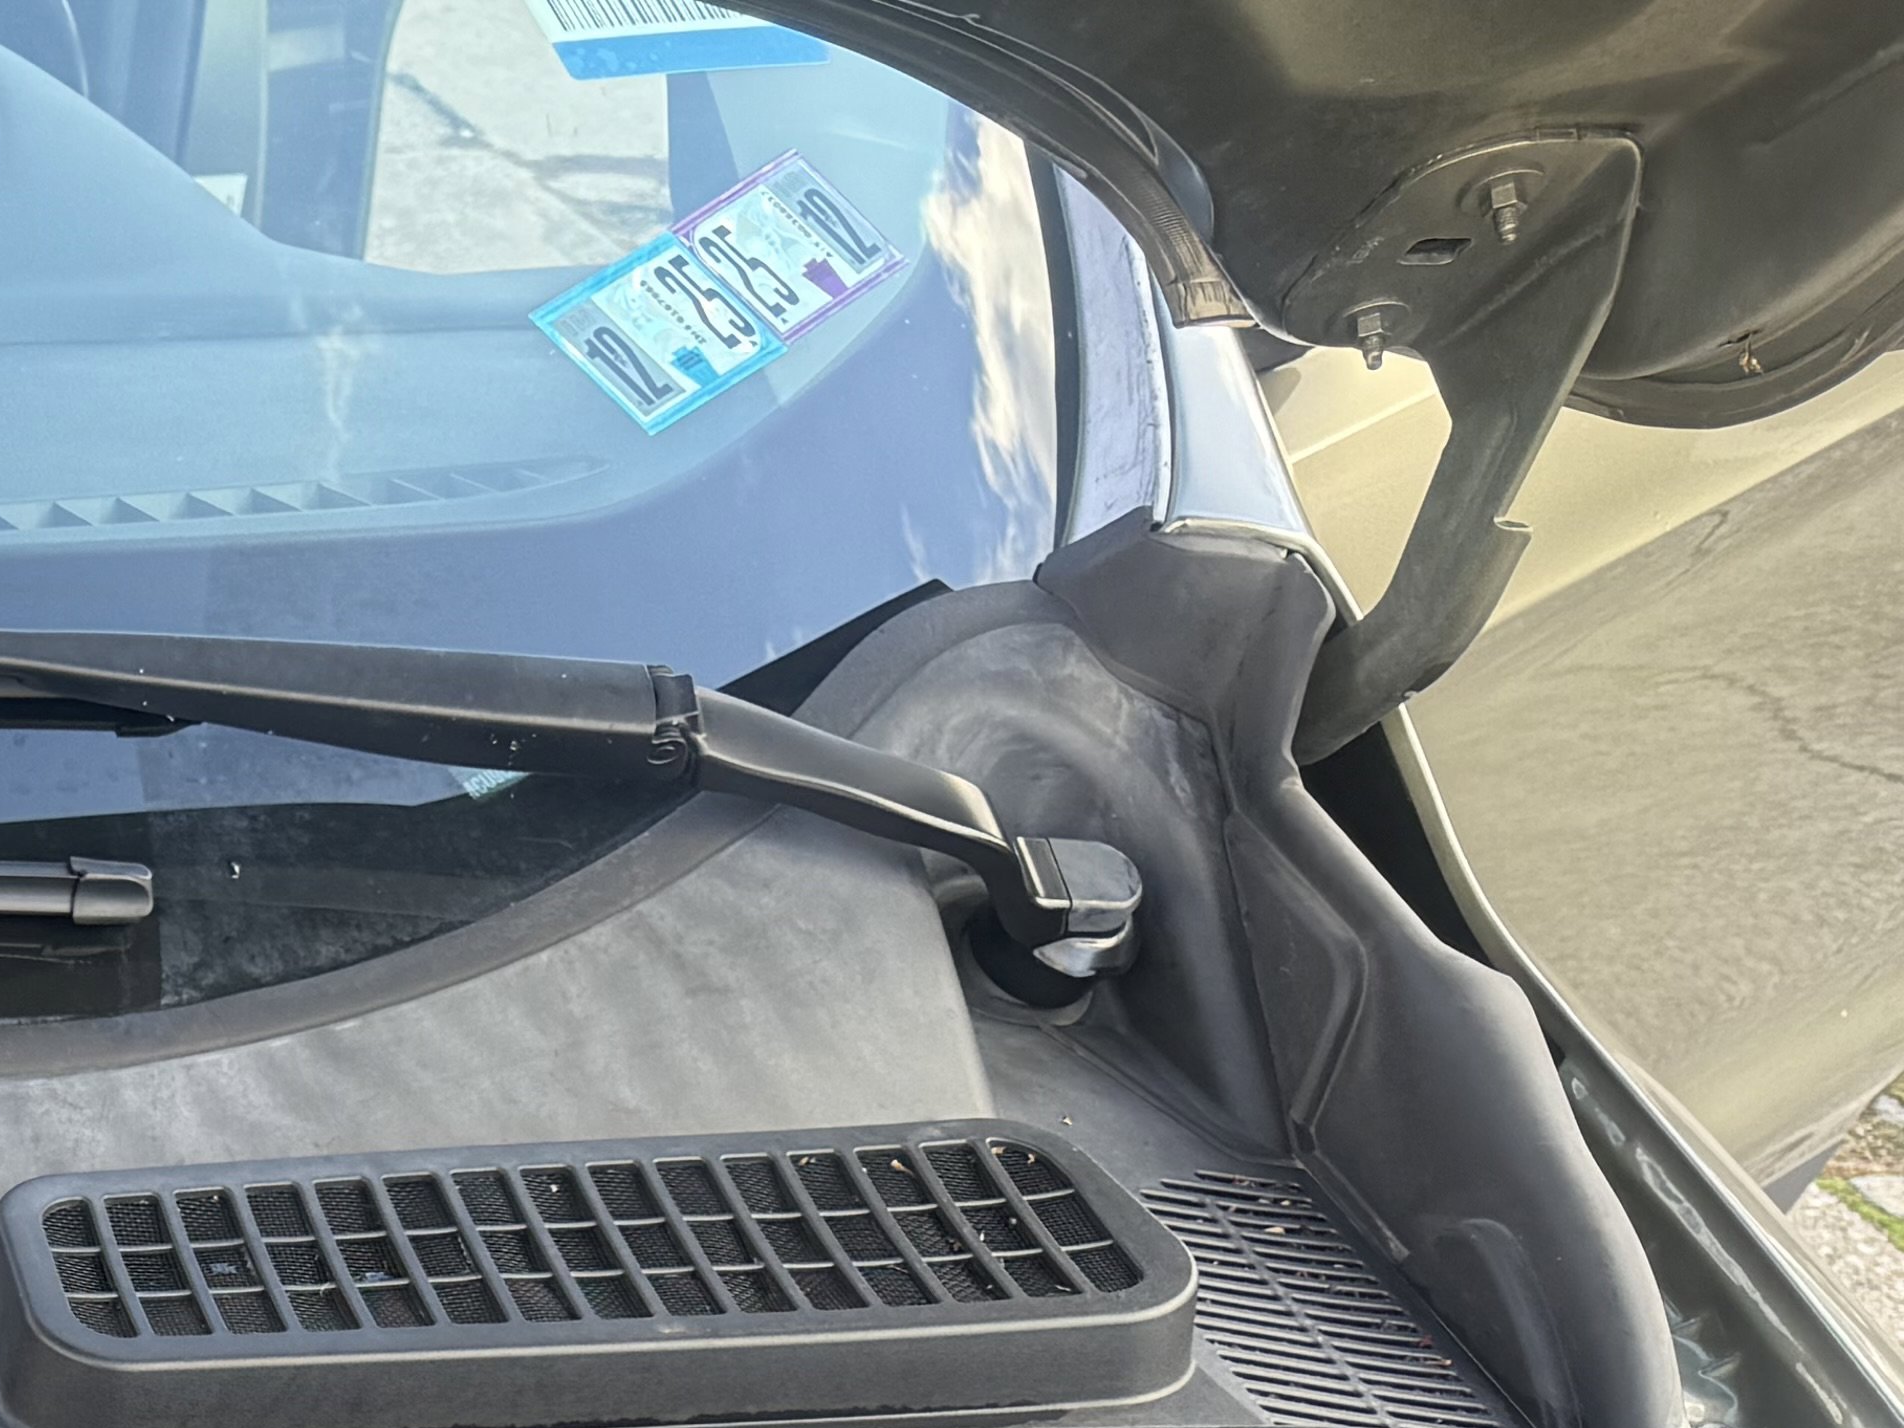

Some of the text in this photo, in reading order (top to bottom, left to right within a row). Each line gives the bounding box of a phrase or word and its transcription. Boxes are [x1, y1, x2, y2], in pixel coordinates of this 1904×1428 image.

[797, 188, 882, 265] 12
[654, 254, 756, 349] 25
[698, 224, 800, 319] 25
[585, 326, 673, 407] 12
